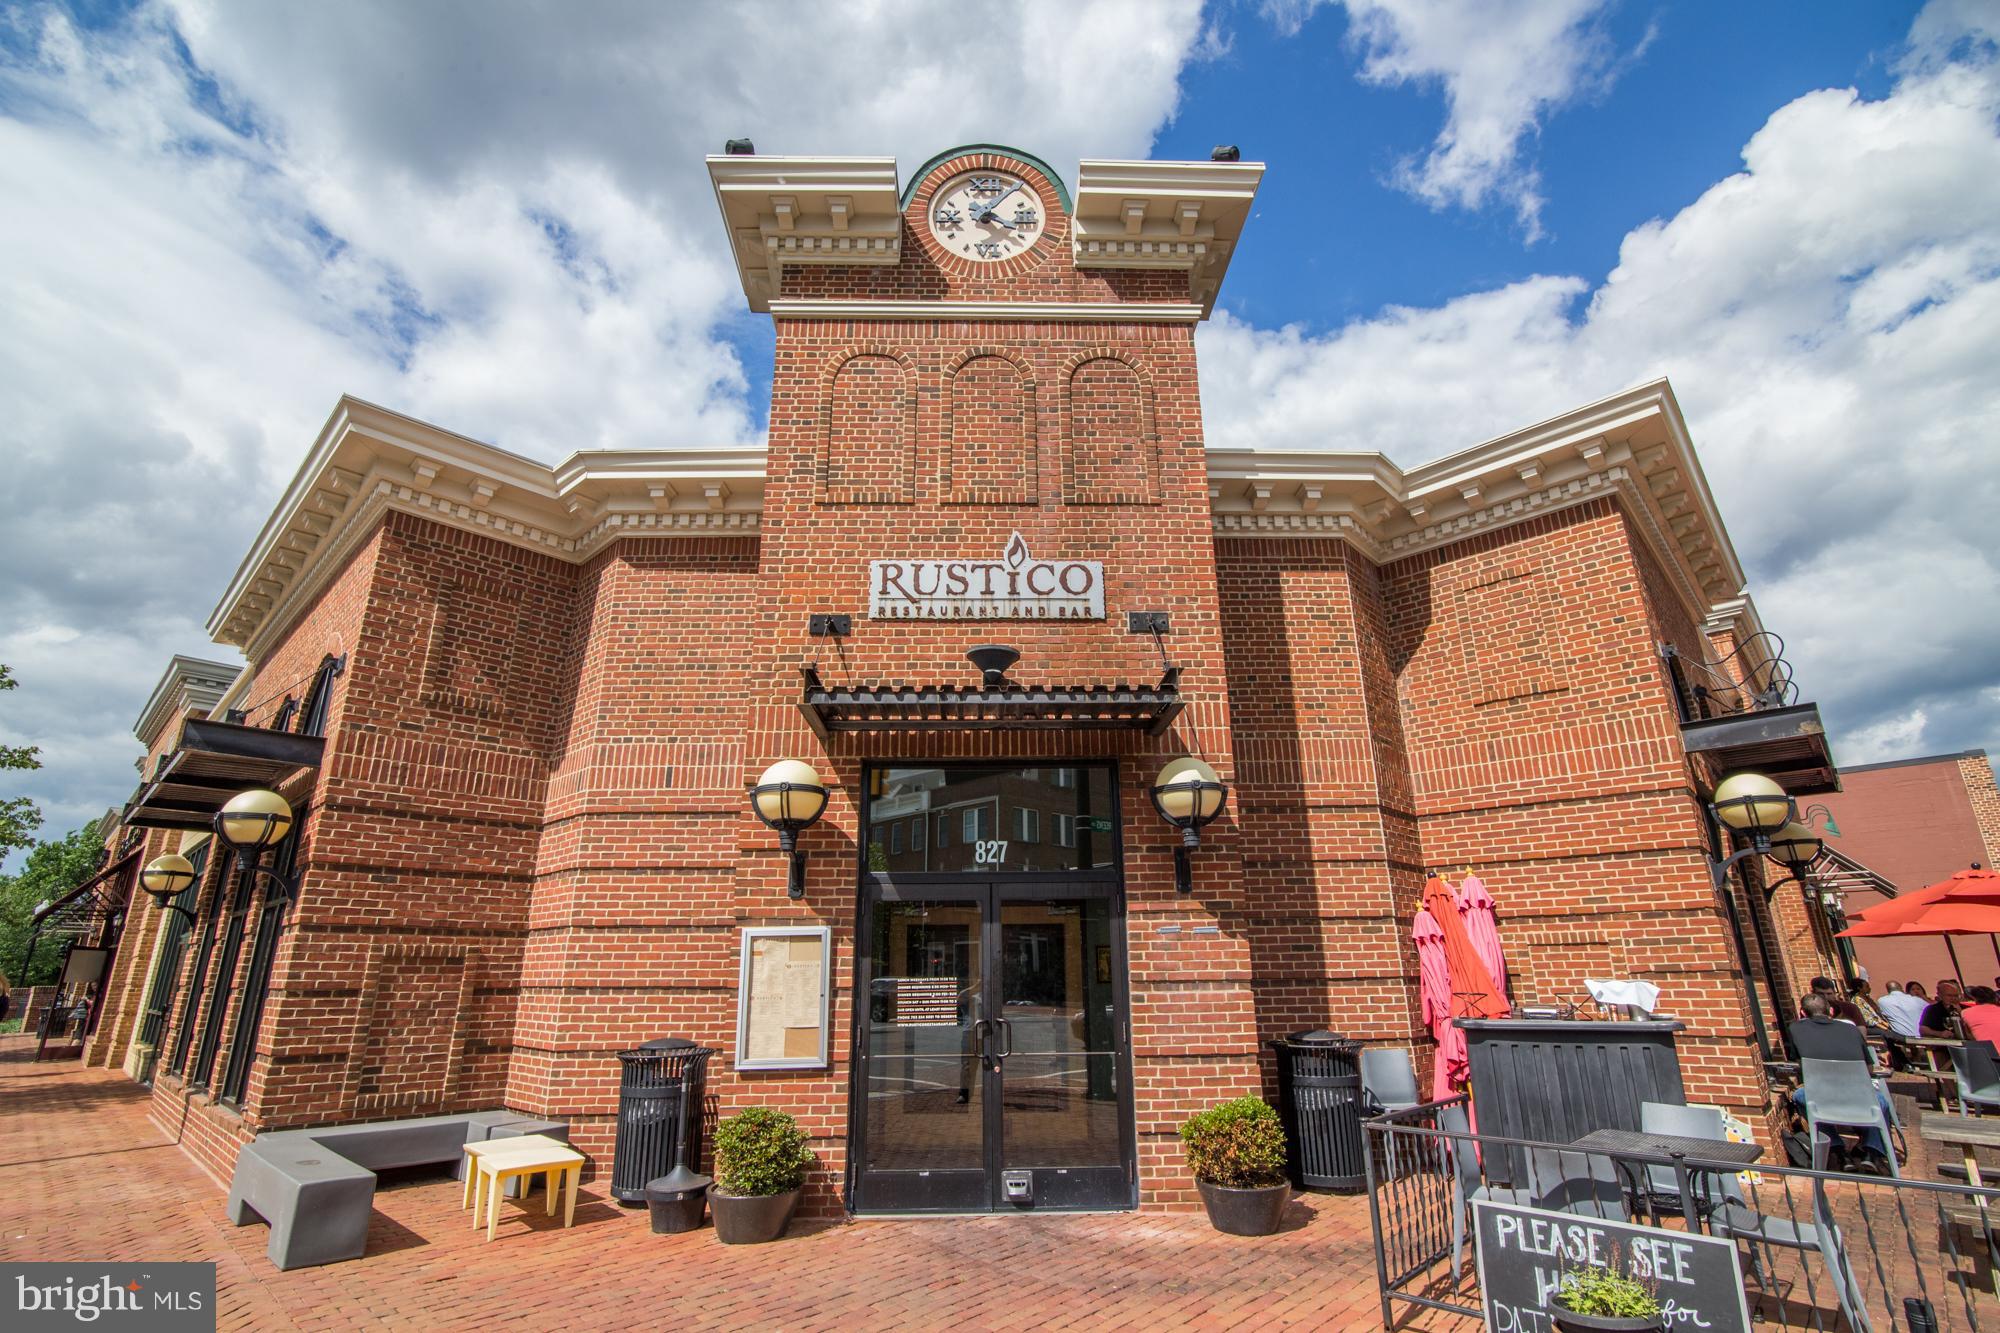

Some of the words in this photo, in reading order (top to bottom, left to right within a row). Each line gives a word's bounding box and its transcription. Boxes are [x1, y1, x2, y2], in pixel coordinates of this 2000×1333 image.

[877, 606, 1000, 618] RESTAURANT
[1011, 606, 1047, 618] AND
[1058, 606, 1093, 618] BAR
[975, 840, 1009, 864] 827
[1496, 1215, 1605, 1267] PLEASE
[1628, 1237, 1695, 1285] SEE
[1661, 1299, 1711, 1327] for
